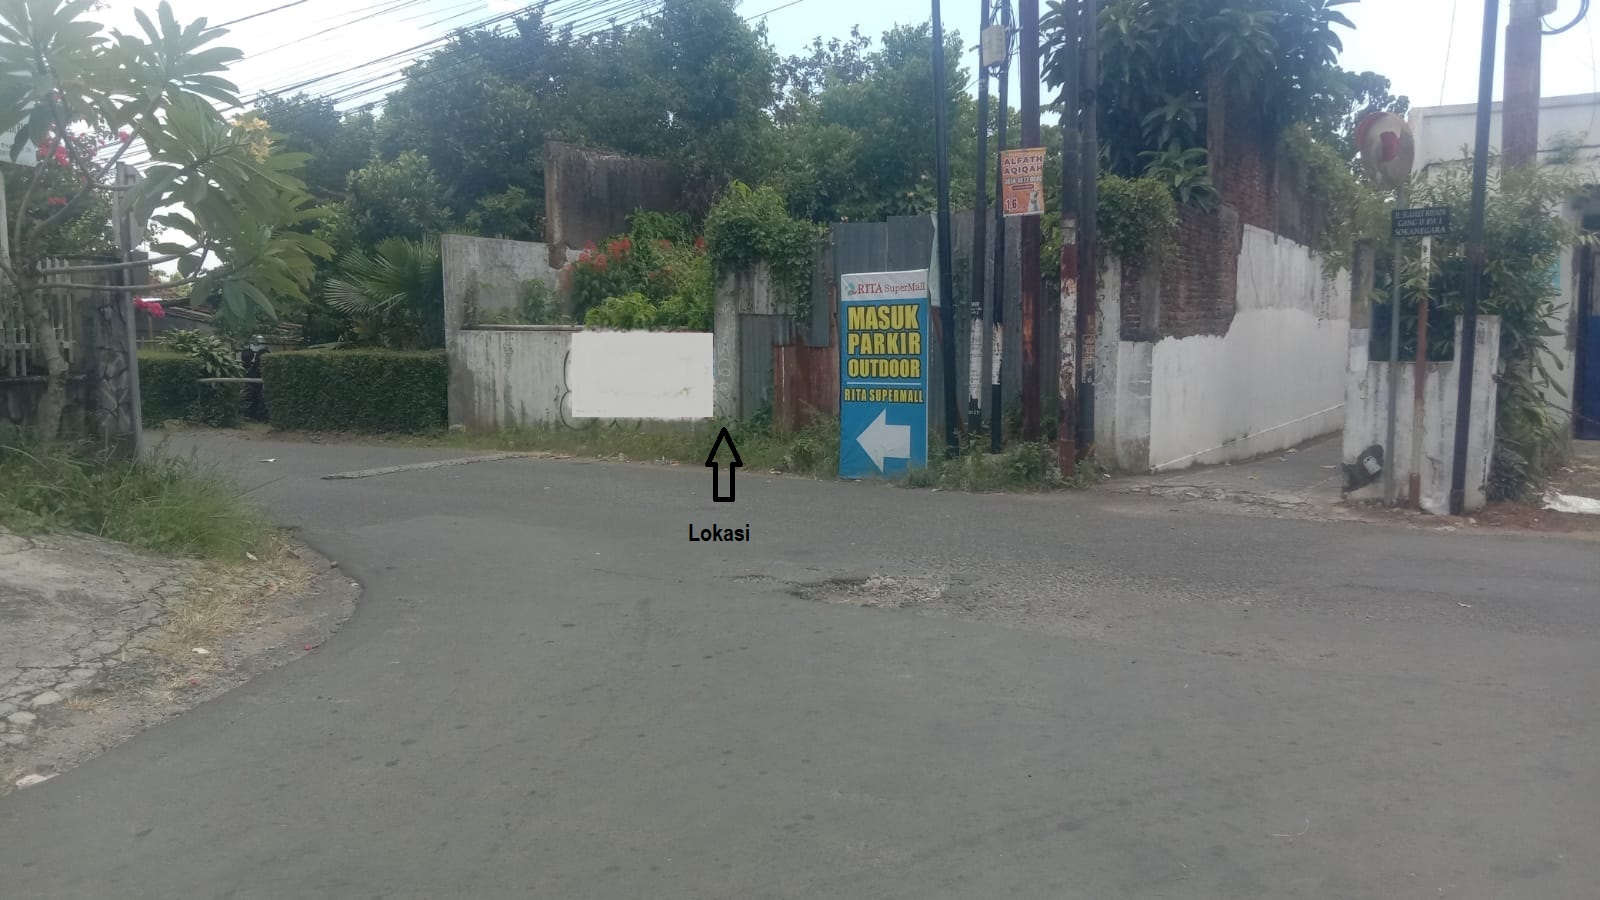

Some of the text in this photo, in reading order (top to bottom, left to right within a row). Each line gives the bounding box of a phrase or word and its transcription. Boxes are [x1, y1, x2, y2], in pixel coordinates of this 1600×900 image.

[1004, 156, 1043, 165] ALFATH
[1004, 165, 1043, 175] AQIQAH
[1398, 218, 1418, 227] GANG
[1395, 225, 1446, 236] SOKANEGARA
[857, 281, 926, 295] RITA SuperMall
[847, 304, 919, 331] MASUK
[847, 332, 921, 355] PARKIR
[847, 358, 921, 378] OUTDOOR
[844, 388, 924, 403] RITA SUPERMALL
